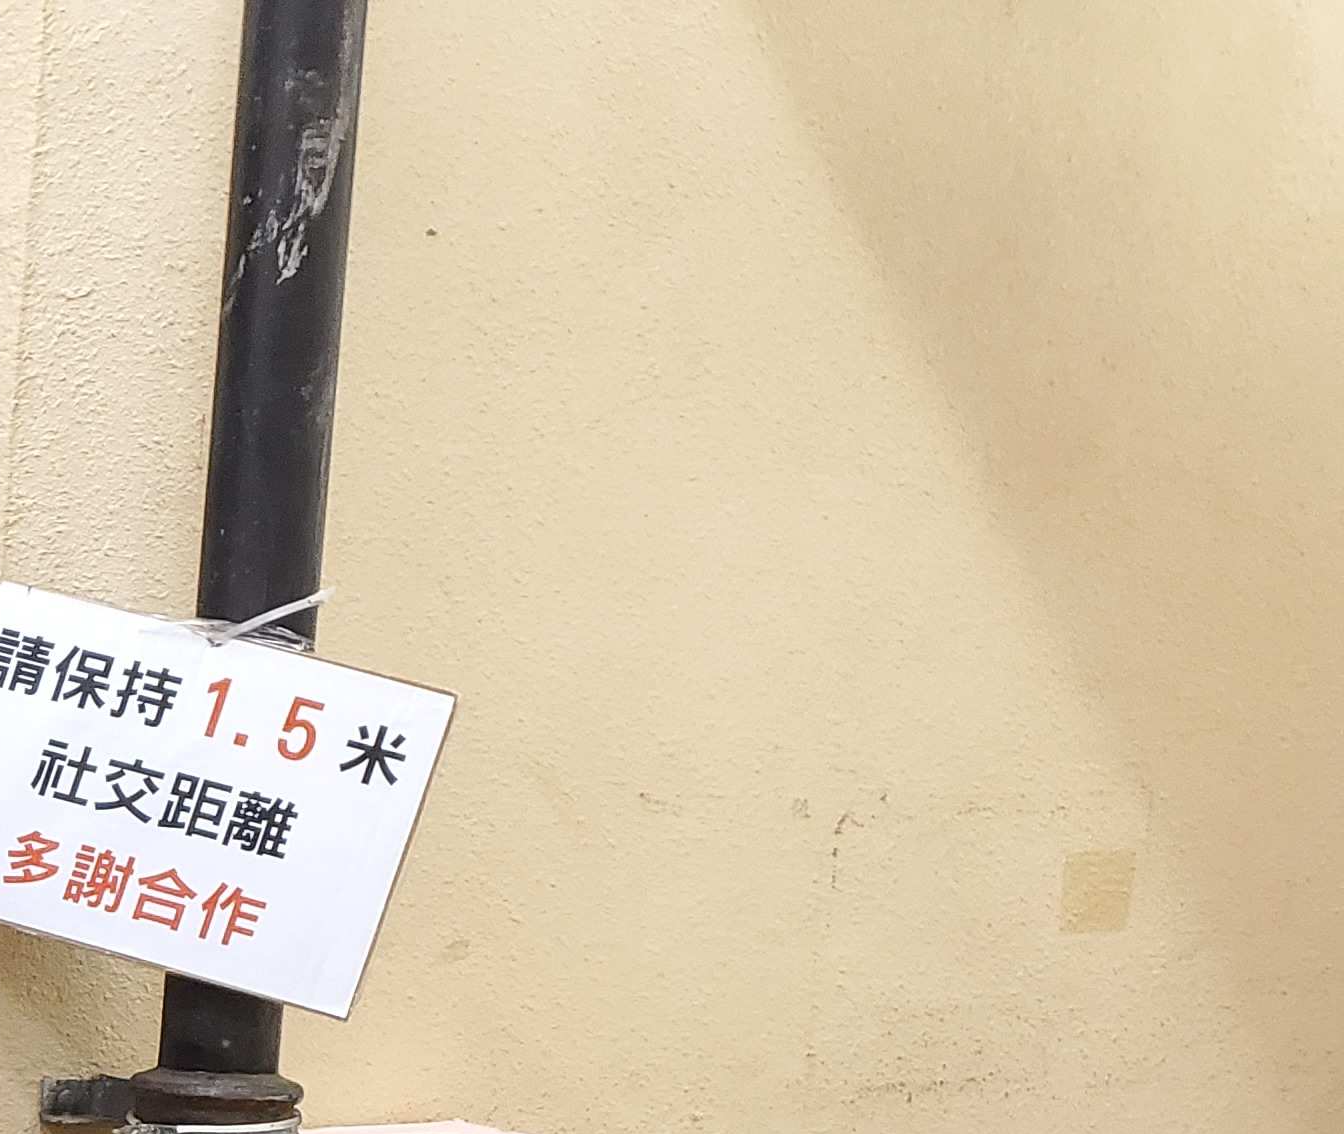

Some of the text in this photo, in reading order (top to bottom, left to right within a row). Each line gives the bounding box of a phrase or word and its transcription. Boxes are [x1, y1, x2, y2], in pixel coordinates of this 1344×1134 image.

[199, 677, 326, 762] 1.5
[339, 723, 407, 787] 米
[30, 736, 299, 860] 社交距離
[2, 829, 268, 947] 多謝合作
